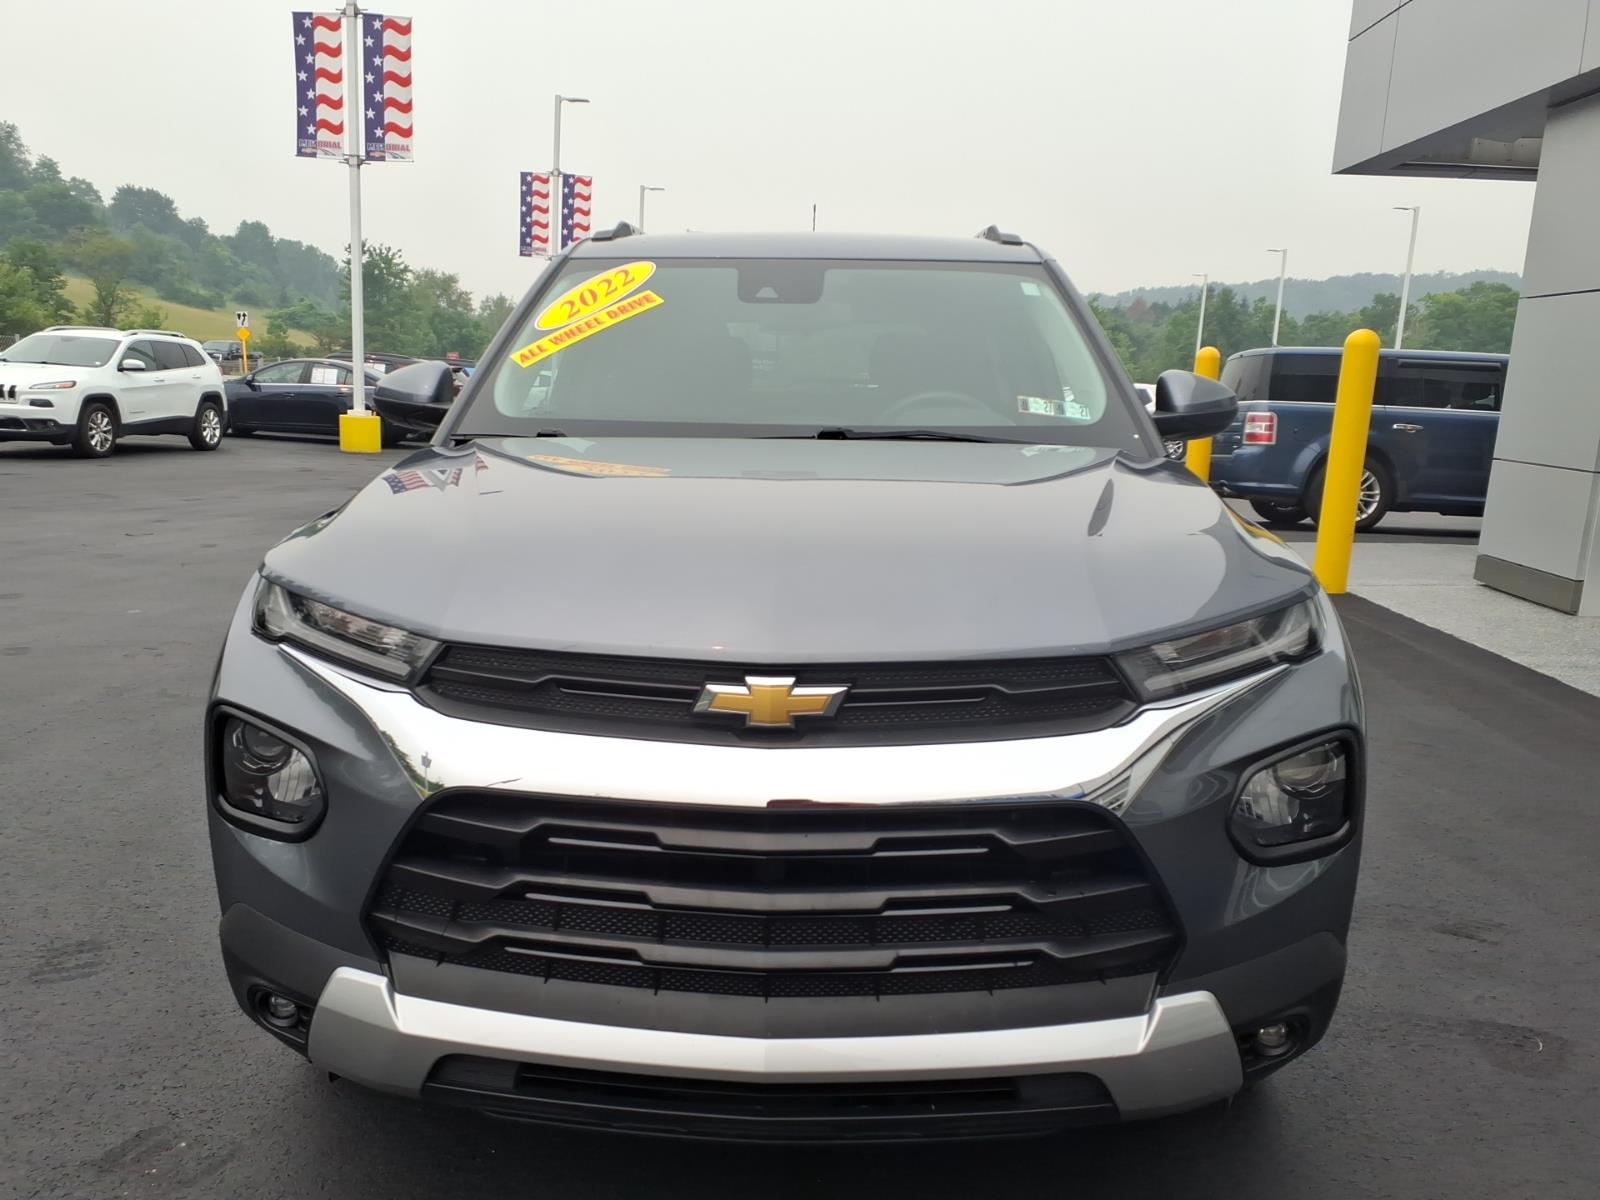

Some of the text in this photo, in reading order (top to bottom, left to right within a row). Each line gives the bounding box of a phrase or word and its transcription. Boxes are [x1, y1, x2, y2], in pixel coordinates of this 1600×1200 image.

[559, 268, 636, 320] 2022
[518, 292, 657, 364] ALL WHEEL DRIVE
